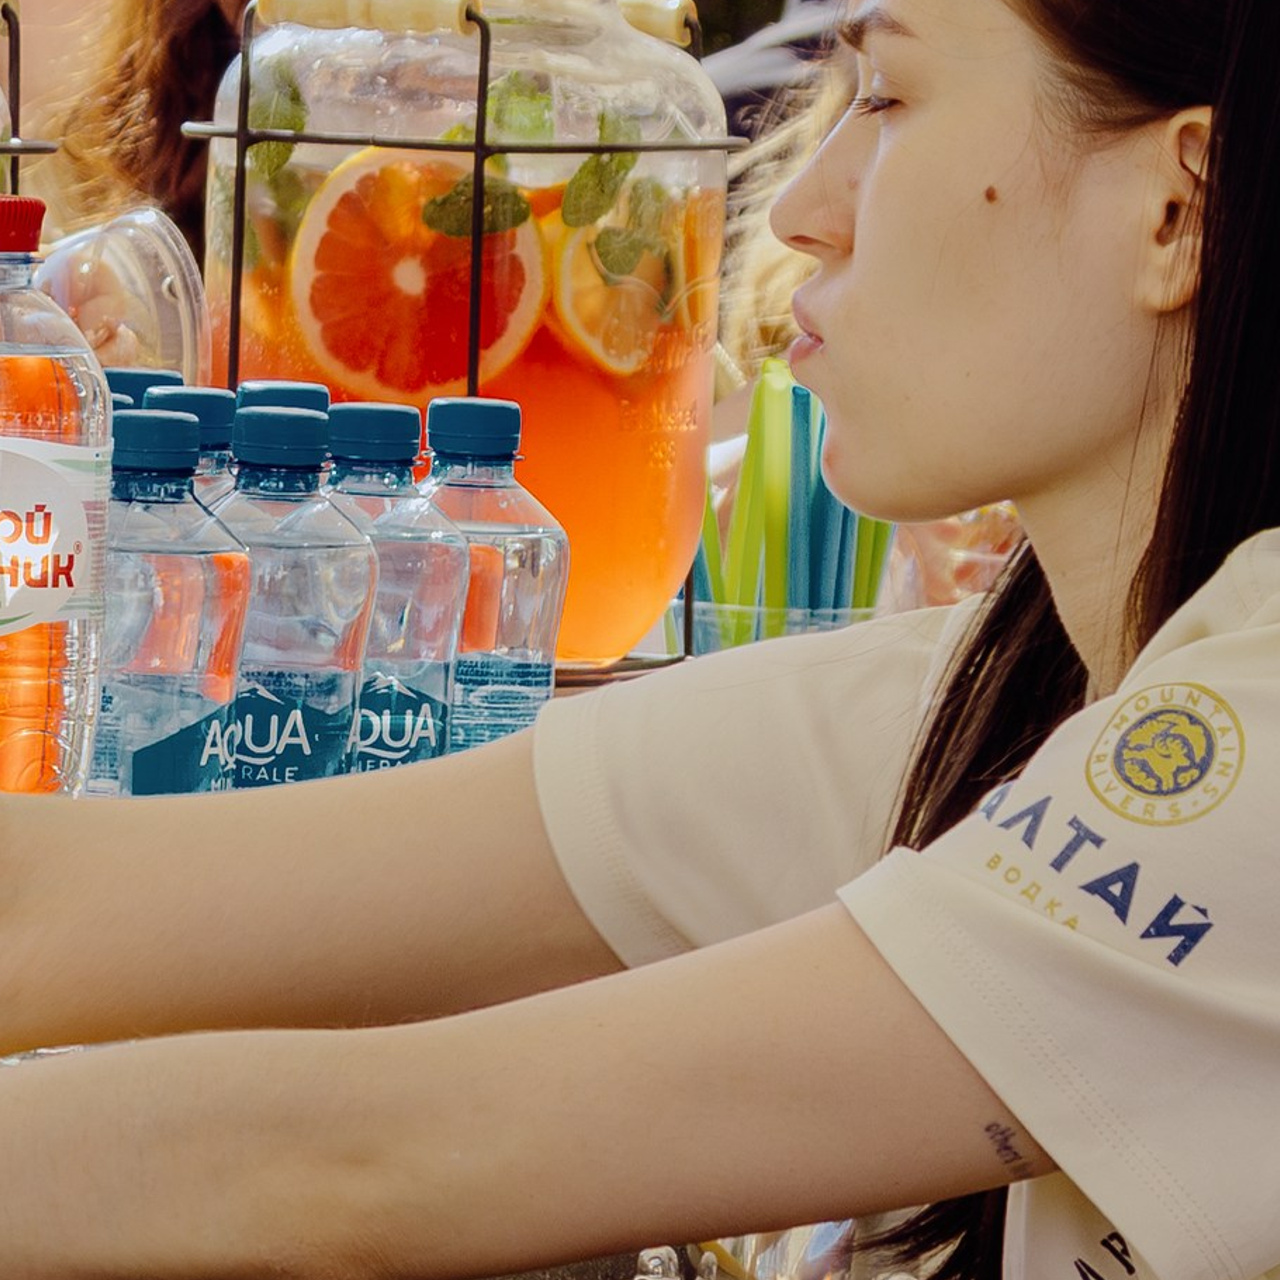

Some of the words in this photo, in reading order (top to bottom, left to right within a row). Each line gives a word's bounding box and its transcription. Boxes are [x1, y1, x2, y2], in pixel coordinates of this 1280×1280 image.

[200, 708, 312, 771] AQUA
[1112, 687, 1236, 798] MOUNTAINS
[1093, 753, 1182, 818] RIVERS
[979, 784, 1214, 967] АЛТАЙ
[986, 853, 1080, 931] ВОДКА
